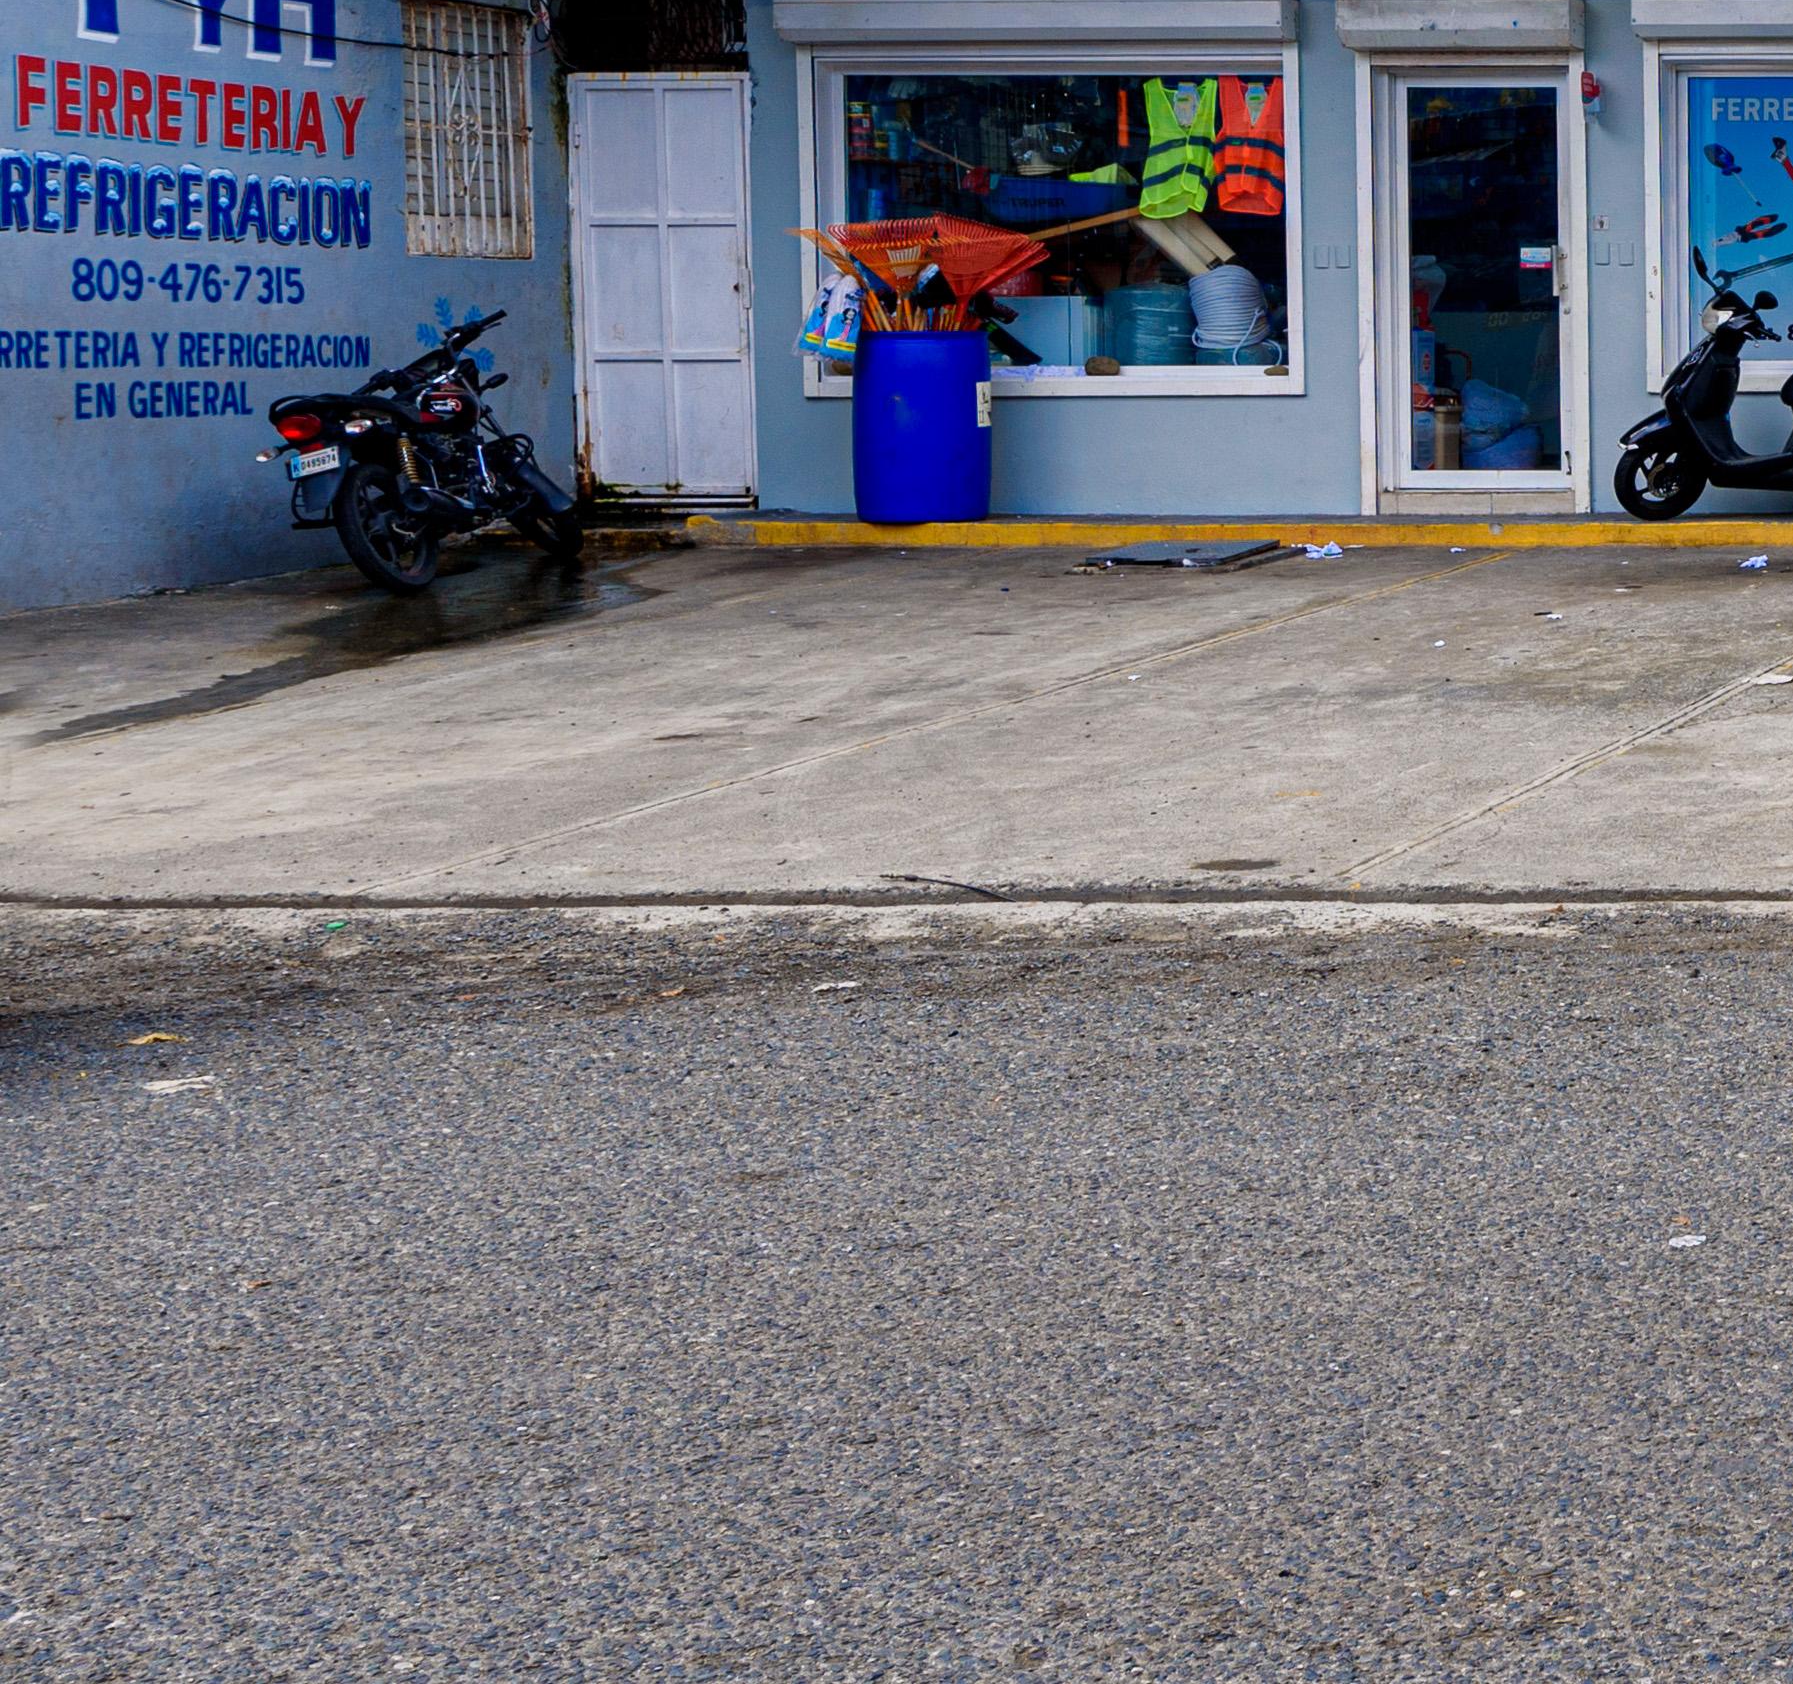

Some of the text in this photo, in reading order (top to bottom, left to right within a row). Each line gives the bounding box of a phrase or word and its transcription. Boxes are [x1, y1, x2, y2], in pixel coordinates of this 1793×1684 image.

[14, 54, 367, 158] FERRETERIA Y
[0, 148, 373, 249] REFRIGERACION
[71, 257, 306, 305] 809-476-7315
[150, 331, 170, 368] Y
[178, 330, 371, 370] REFRIGERACION
[75, 379, 254, 421] EN GENERAL
